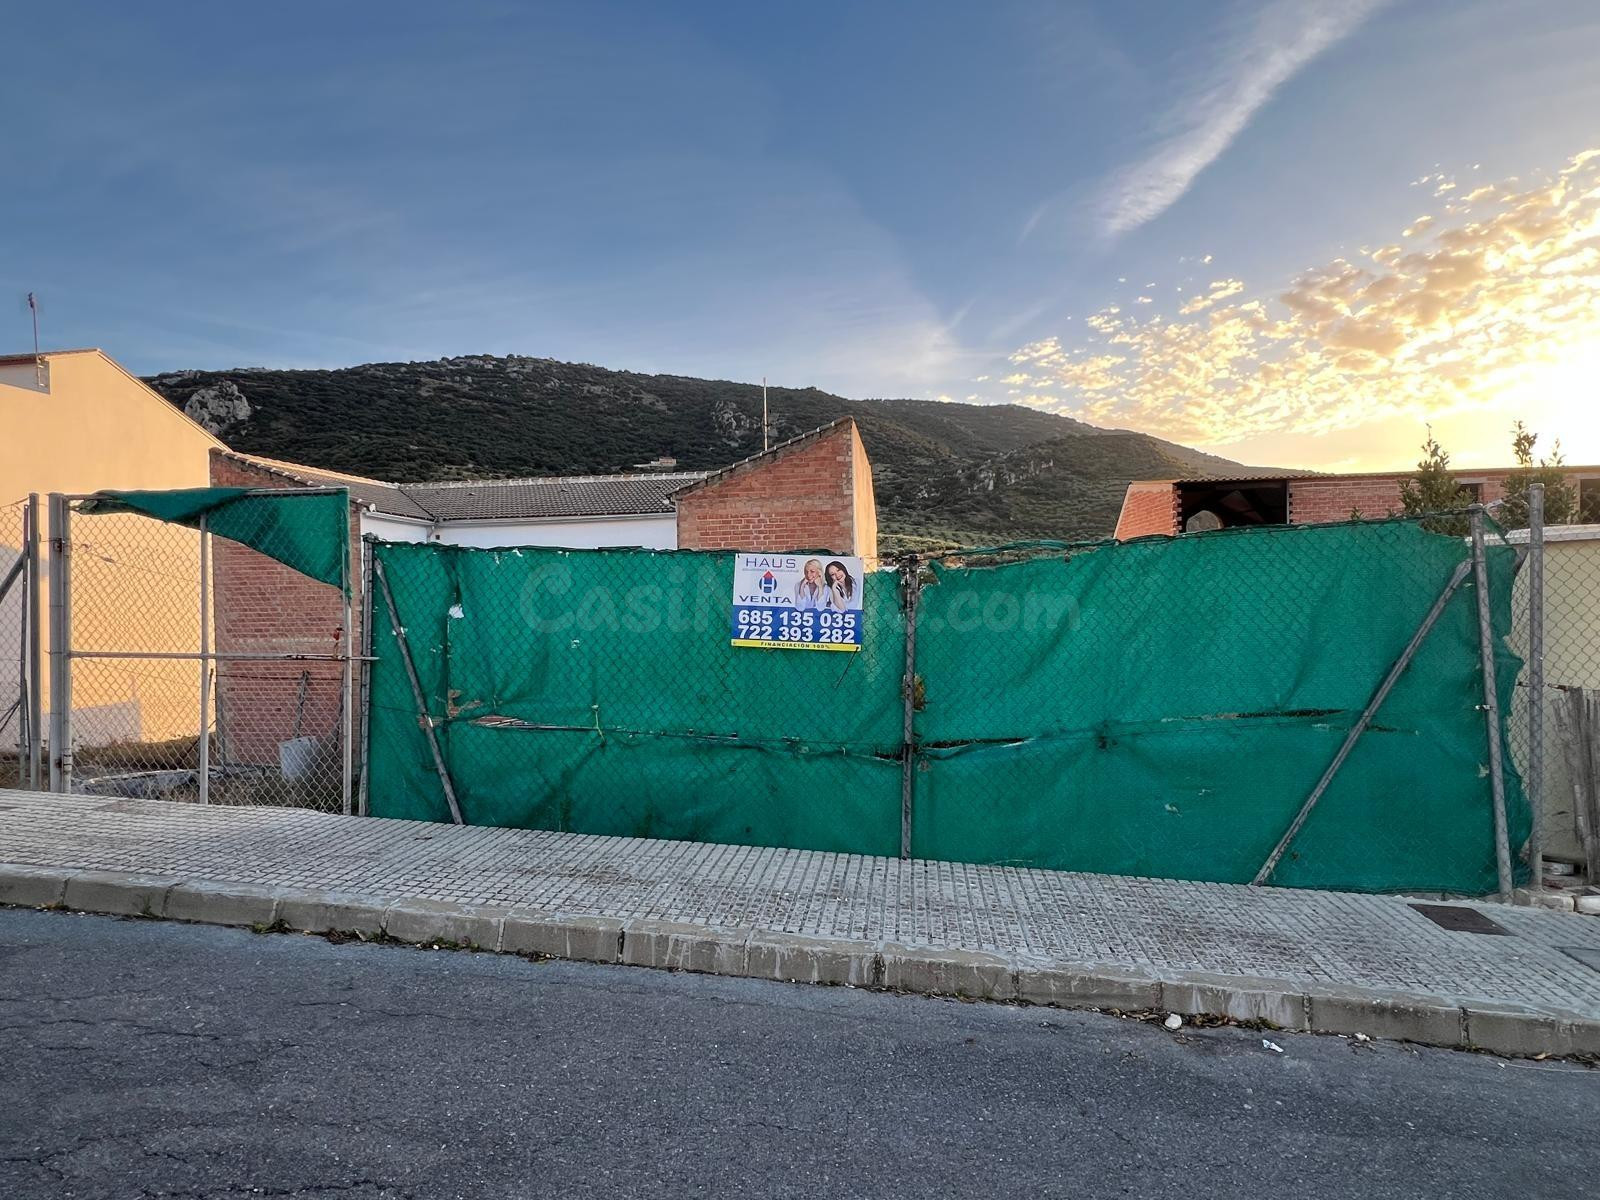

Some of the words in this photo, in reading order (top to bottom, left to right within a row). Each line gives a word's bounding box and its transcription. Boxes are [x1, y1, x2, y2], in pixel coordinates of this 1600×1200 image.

[746, 557, 796, 568] HAUS
[739, 595, 792, 604] VENTA
[738, 610, 773, 625] 685
[779, 611, 814, 626] 135
[819, 613, 856, 628] 035
[738, 625, 773, 639] 722
[778, 627, 813, 641] 393
[819, 629, 855, 643] 282
